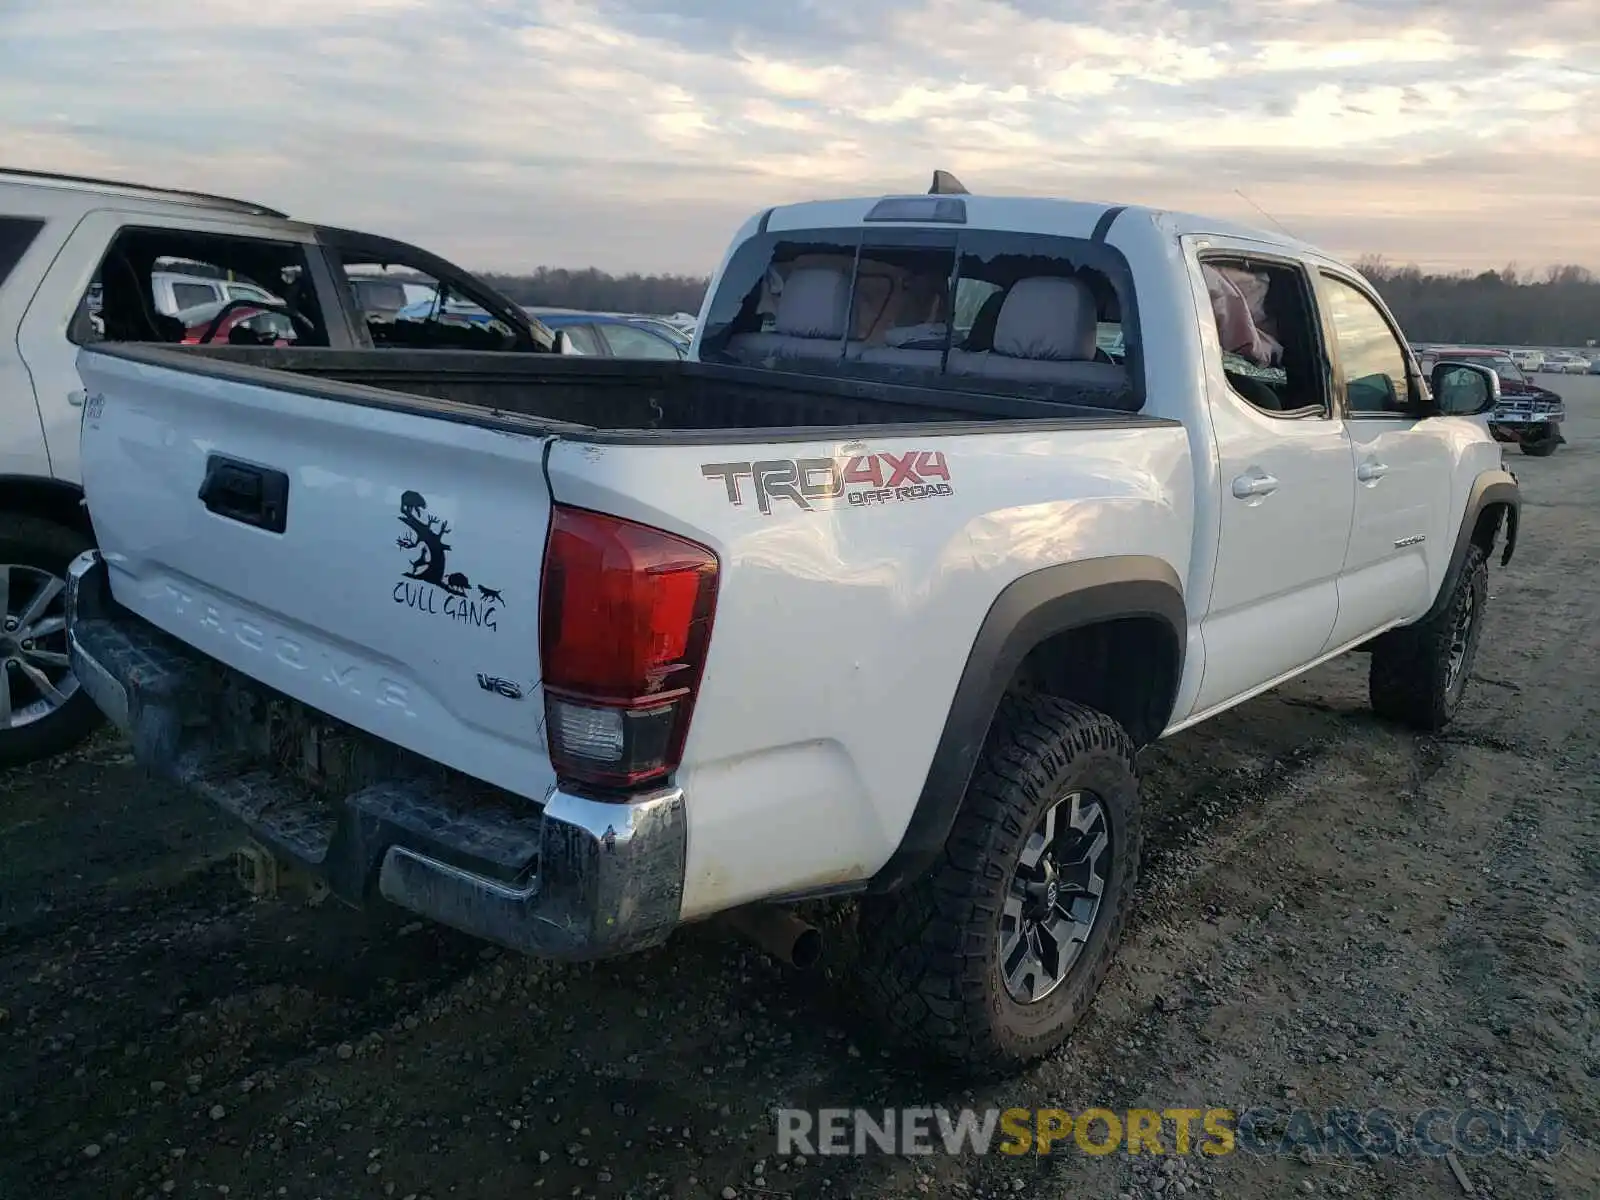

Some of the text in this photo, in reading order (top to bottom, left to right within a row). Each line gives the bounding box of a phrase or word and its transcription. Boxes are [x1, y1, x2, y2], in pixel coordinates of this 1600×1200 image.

[701, 457, 844, 515] TRD
[848, 482, 954, 506] OFF ROAD
[393, 582, 497, 632] CULL GANG
[477, 672, 523, 700] V6
